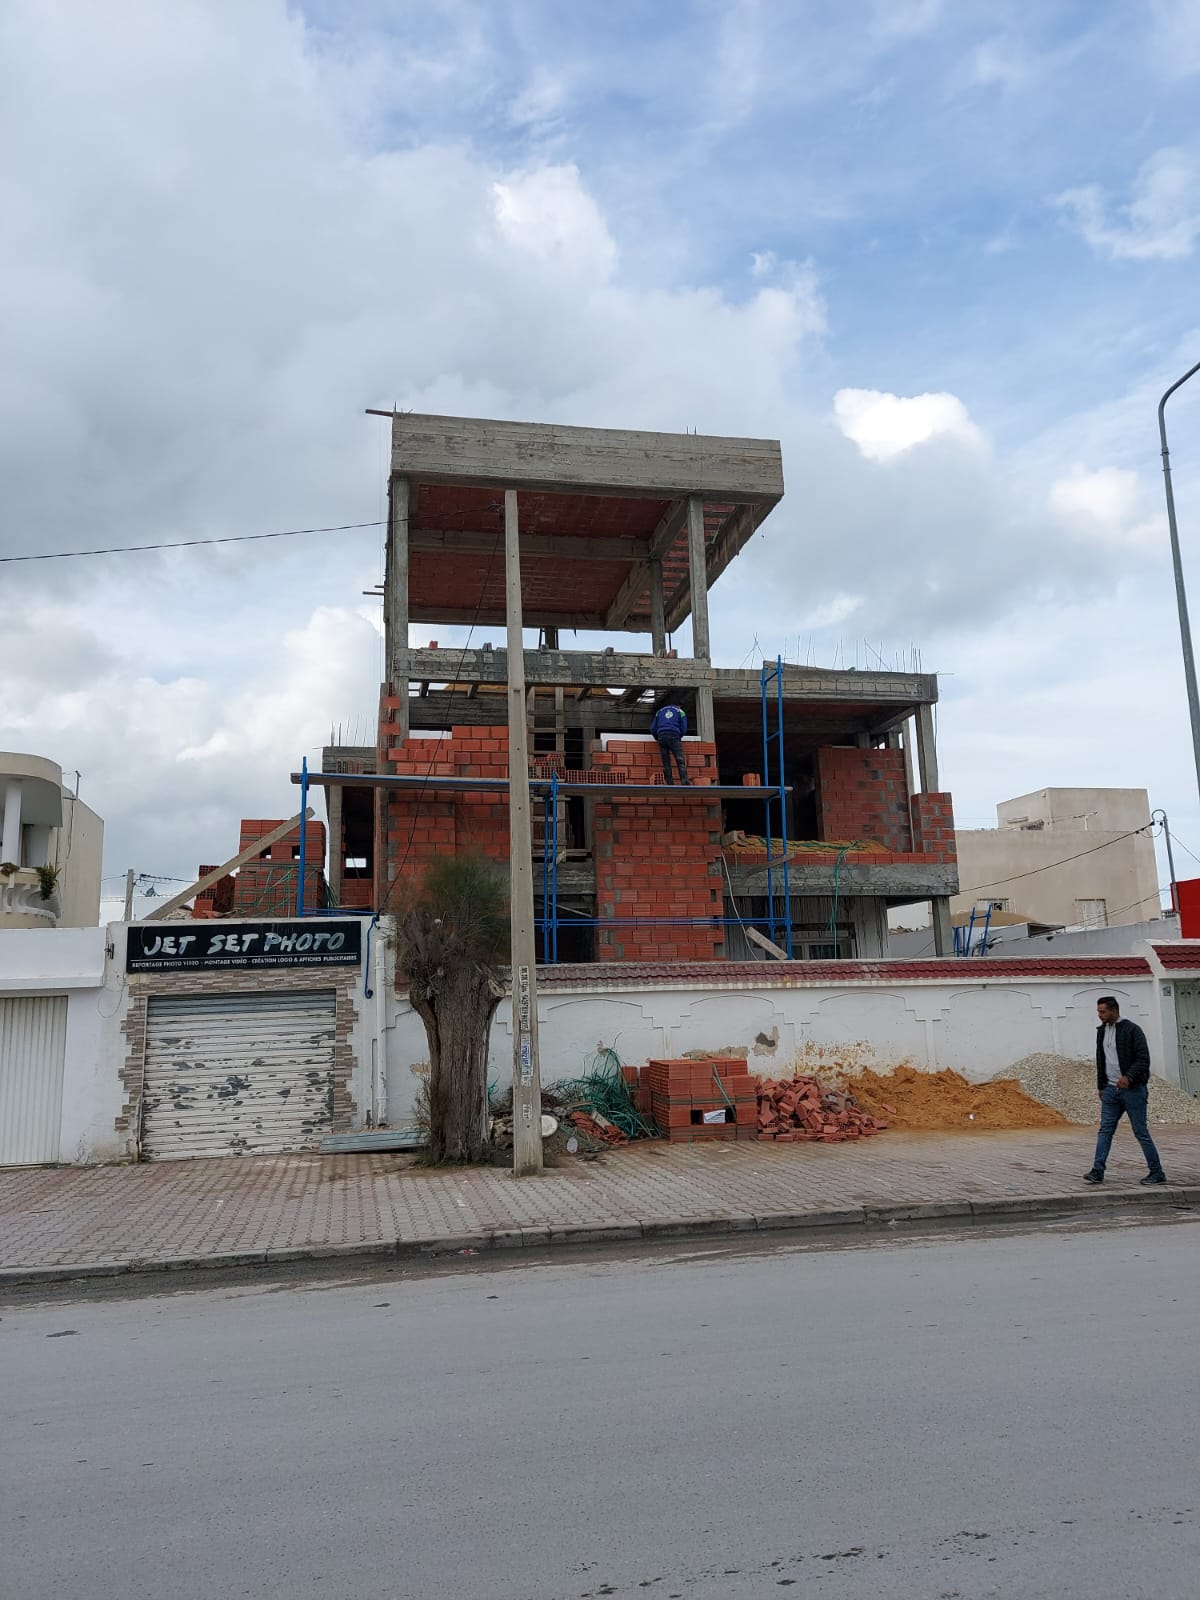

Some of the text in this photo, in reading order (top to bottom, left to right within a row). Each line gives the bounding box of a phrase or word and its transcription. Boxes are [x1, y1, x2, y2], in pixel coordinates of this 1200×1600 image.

[144, 932, 345, 956] JET SET PHOTO
